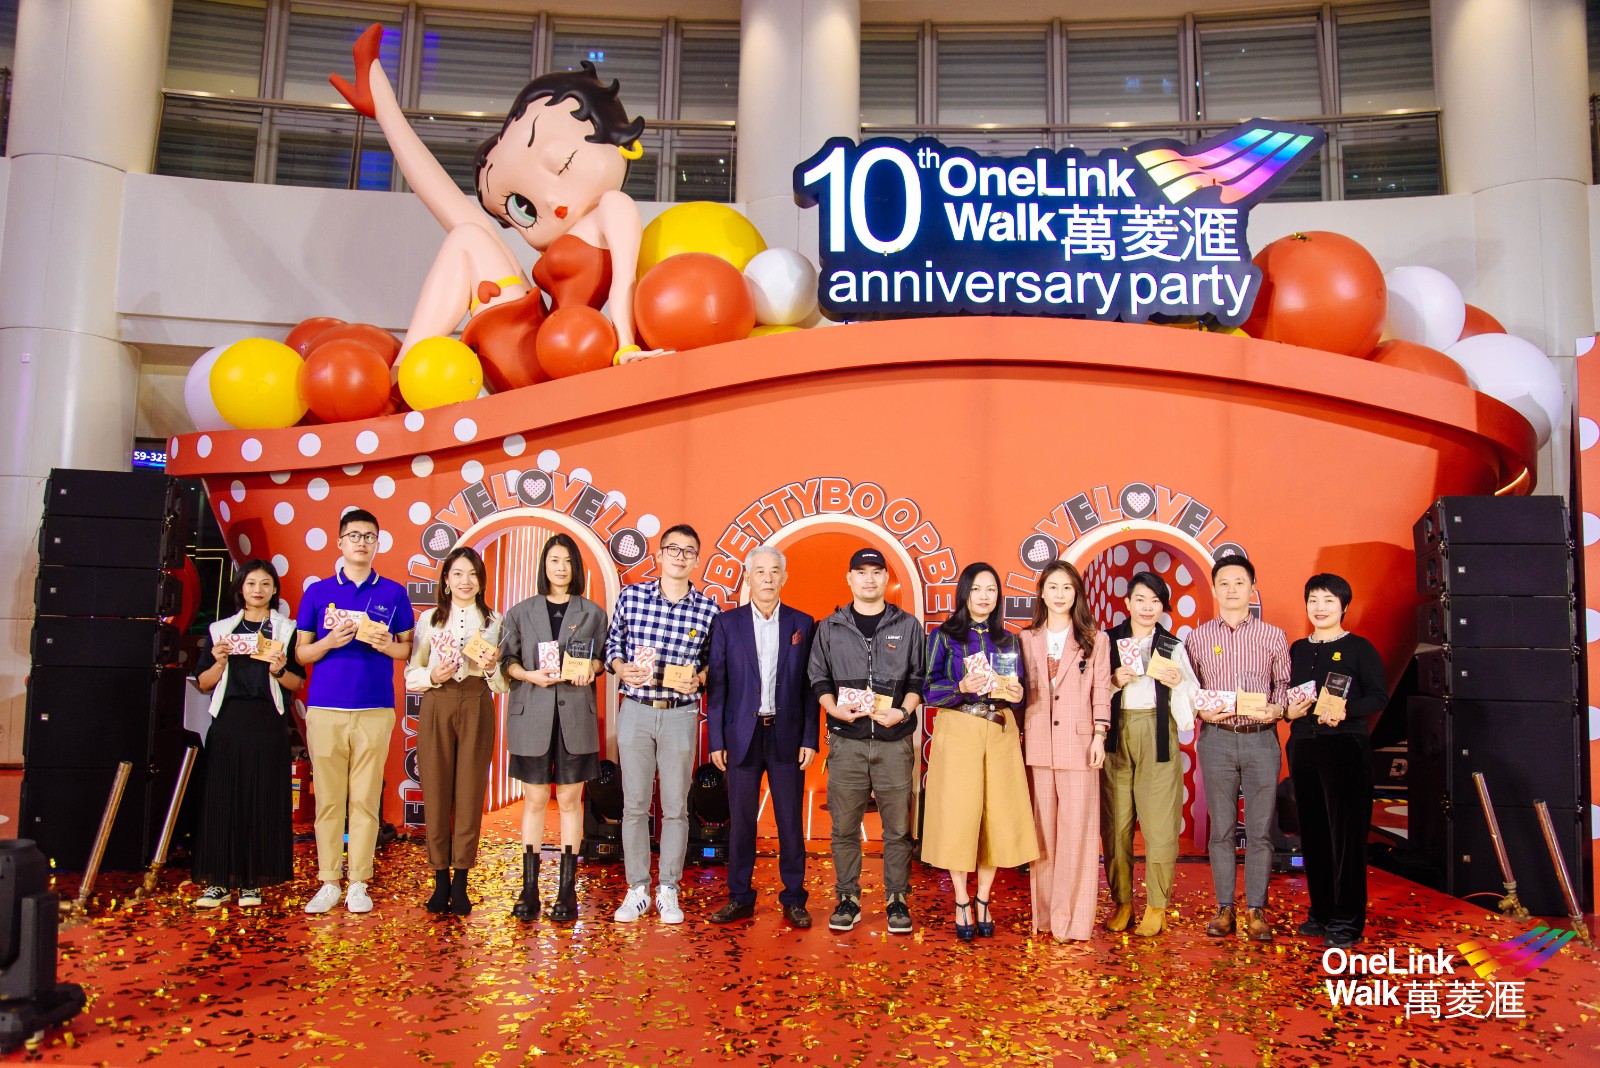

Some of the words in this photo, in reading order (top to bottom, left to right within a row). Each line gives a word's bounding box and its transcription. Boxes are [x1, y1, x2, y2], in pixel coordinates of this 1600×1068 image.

[939, 158, 1136, 197] OneLink
[944, 203, 1057, 242] Walk
[829, 262, 1121, 314] anniversary
[1130, 265, 1251, 316] party
